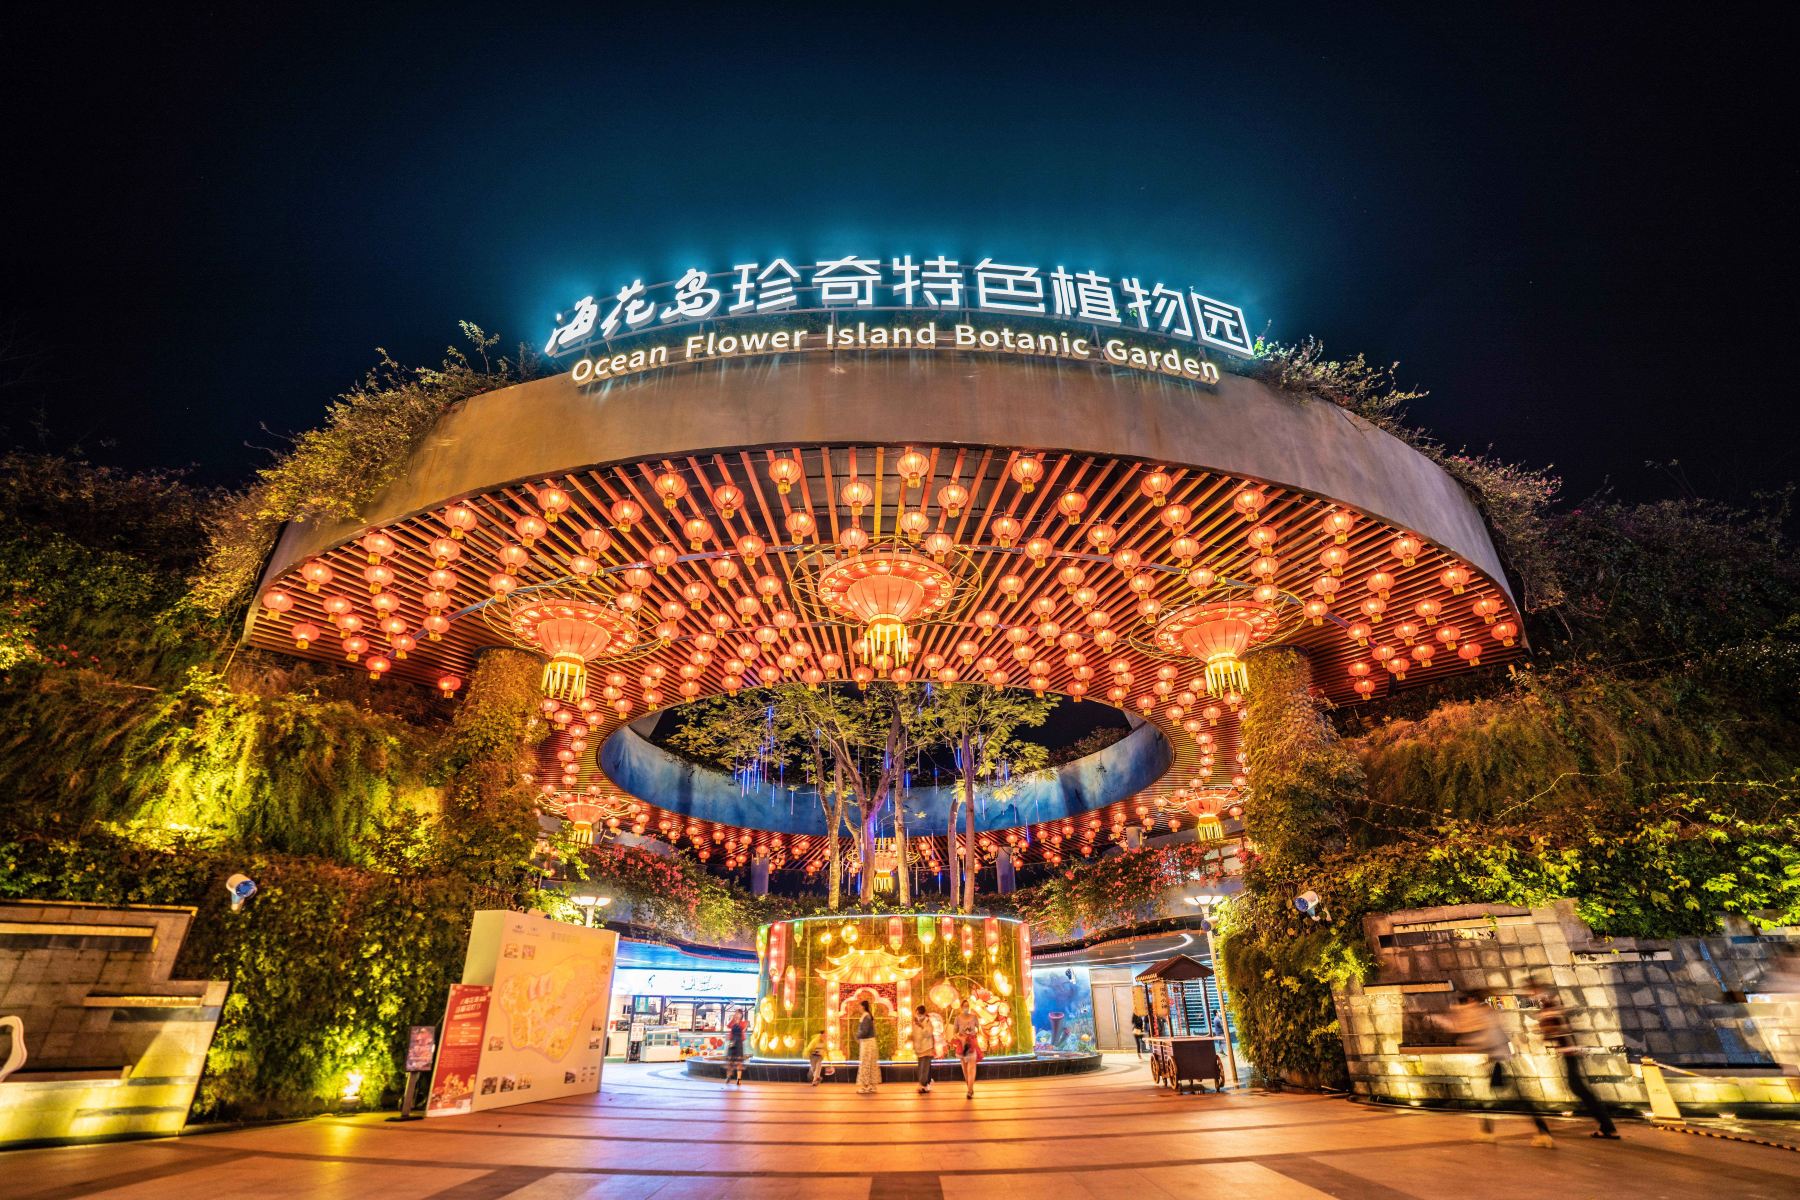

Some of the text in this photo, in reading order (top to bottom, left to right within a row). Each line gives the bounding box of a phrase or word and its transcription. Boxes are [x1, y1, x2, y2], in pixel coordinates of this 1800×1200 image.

[545, 254, 1255, 358] 海花岛珍奇特色植物园
[571, 321, 1221, 384] Ocean Flower Island Botanic Garden
